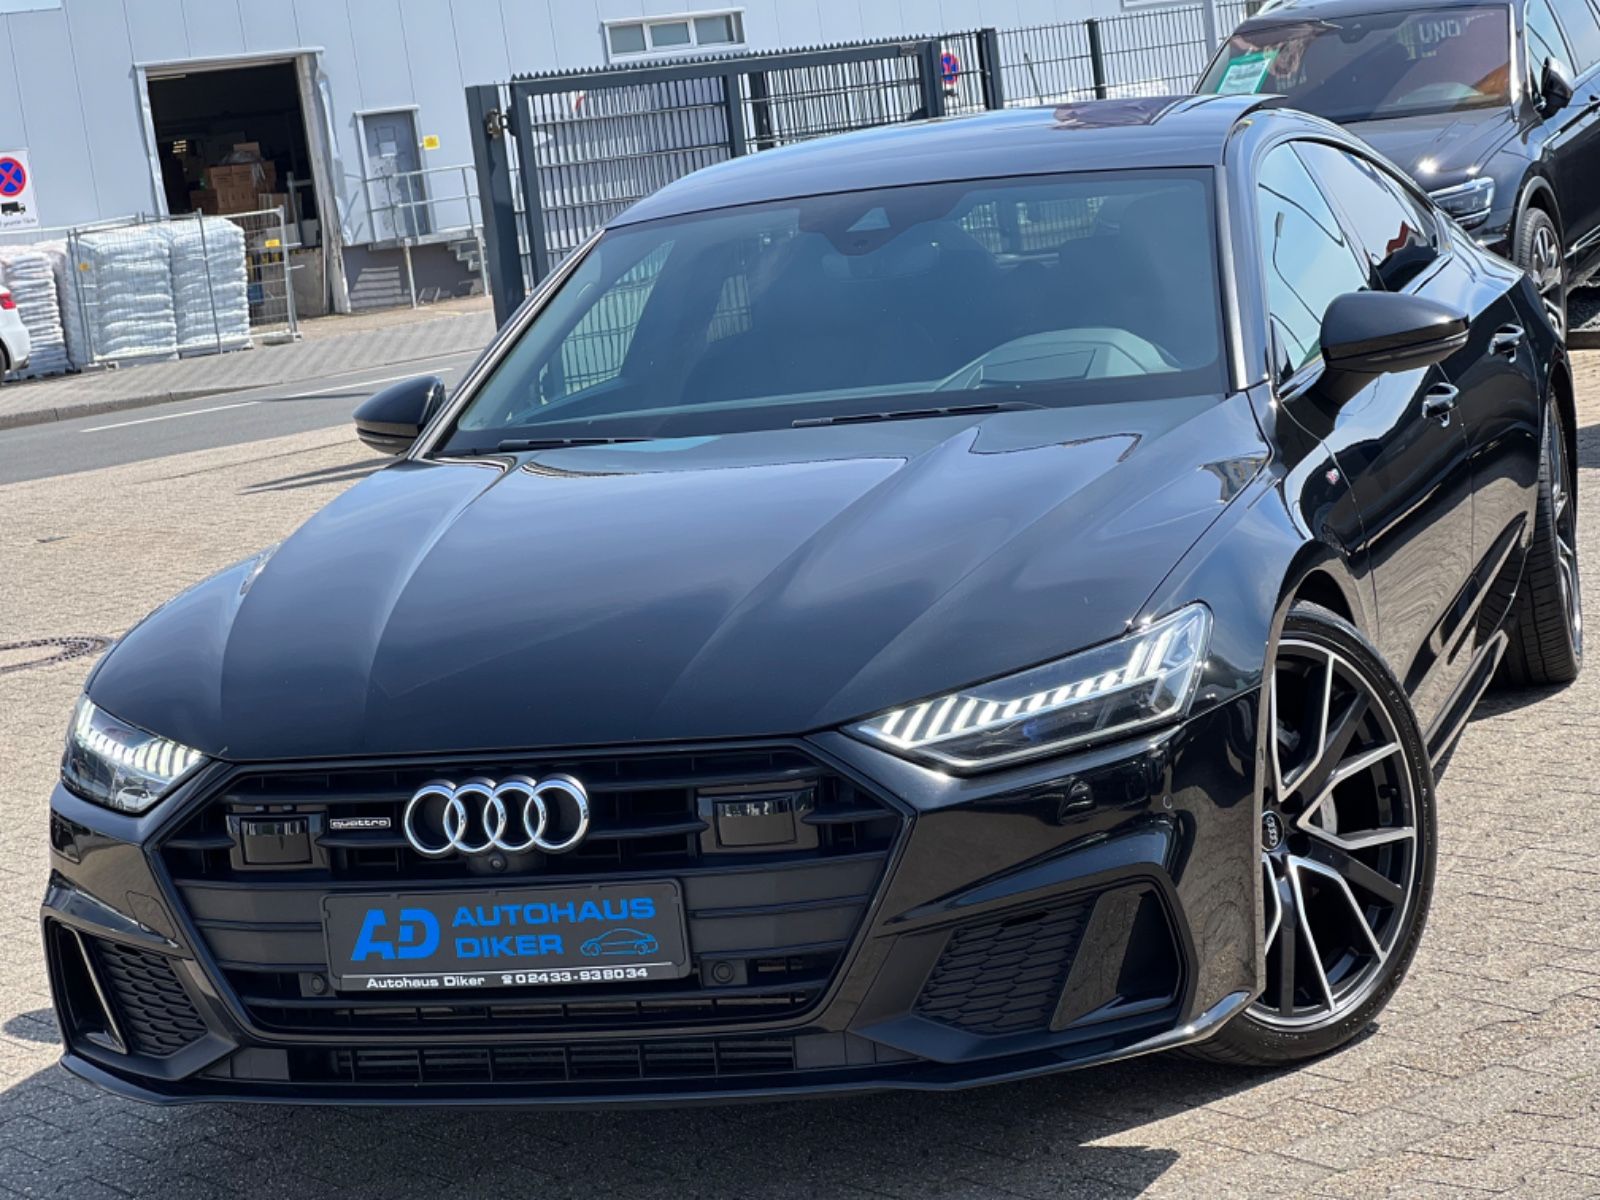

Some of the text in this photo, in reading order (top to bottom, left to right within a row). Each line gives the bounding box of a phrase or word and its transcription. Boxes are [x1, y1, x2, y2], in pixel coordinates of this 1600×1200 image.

[332, 819, 388, 829] quattro
[451, 897, 656, 928] AUTOHAUS
[350, 908, 441, 961] AD
[454, 934, 565, 959] DIKER
[366, 967, 648, 989] Autohaus Diker 02433-938034
